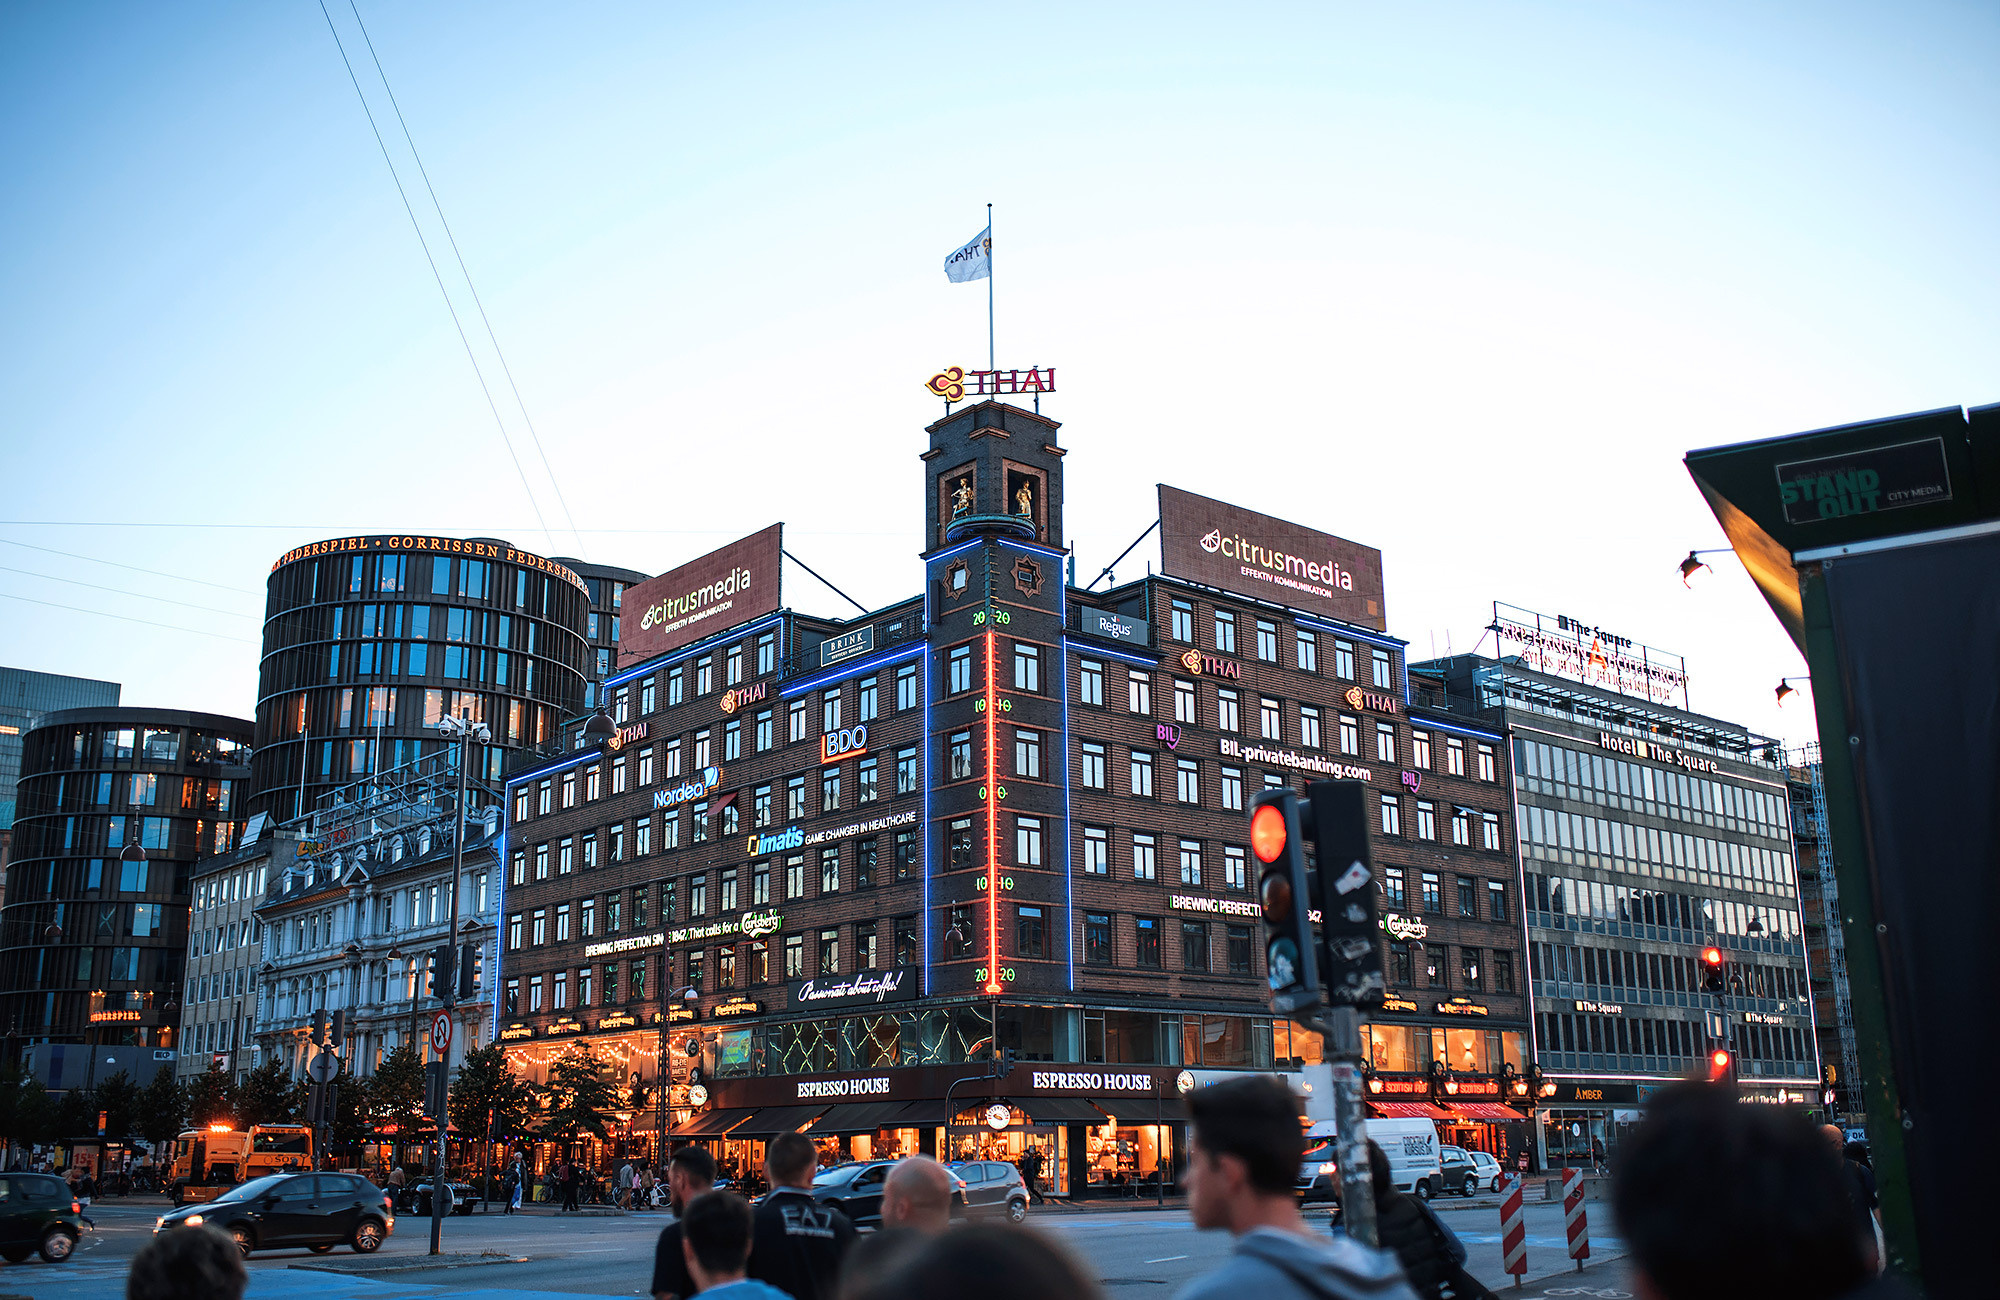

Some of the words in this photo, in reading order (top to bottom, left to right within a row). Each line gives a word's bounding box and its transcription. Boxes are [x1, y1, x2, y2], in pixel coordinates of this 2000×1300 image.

[969, 368, 1057, 395] THAI
[1779, 469, 1880, 505] STAND
[1888, 490, 1910, 502] CITY
[1911, 485, 1944, 498] MEDIA
[1817, 490, 1881, 519] OUT
[283, 538, 368, 565] FEDERSPIEL
[388, 536, 499, 558] GORRISSEN
[1220, 533, 1354, 592] citrusmedia
[1240, 566, 1273, 583] EFFEKTIV
[1273, 575, 1333, 599] KOMMUNIKATION
[653, 567, 751, 625] citrusmedia
[665, 617, 689, 634] EFFEKTIV
[688, 600, 733, 625] KOMMUNIKATION
[973, 611, 986, 625] 20
[995, 610, 1010, 624] 20
[1099, 616, 1131, 638] Regus
[830, 632, 864, 652] BRINK
[1568, 618, 1591, 637] The
[1594, 626, 1632, 649] Square
[1203, 655, 1240, 679] THAI
[736, 682, 767, 707] THAI
[975, 699, 986, 712] 10
[998, 699, 1011, 711] 10
[1364, 692, 1397, 713] THAI
[622, 722, 648, 744] THAI
[827, 725, 867, 756] BDO
[1157, 724, 1176, 743] BIL
[1220, 738, 1372, 782] BIL-privatebanking.com
[1600, 731, 1637, 756] Hotel
[1647, 742, 1673, 764] The
[1675, 749, 1718, 774] Square
[1402, 771, 1418, 788] BIL
[653, 782, 705, 809] Nordea
[979, 786, 987, 800] 0
[997, 786, 1006, 799] 0
[758, 825, 805, 856] imatis
[805, 833, 826, 846] GAME
[825, 824, 860, 841] CHANGER
[860, 822, 869, 834] IN
[869, 811, 917, 831] HEALTHCARE
[976, 877, 988, 891] 10
[1000, 876, 1013, 890] 10
[1172, 894, 1219, 913] BREWING
[1386, 913, 1430, 940] Carlsberg
[585, 941, 613, 957] BREWING
[613, 934, 652, 953] PERFECTION
[689, 925, 705, 940] That
[705, 923, 722, 938] calls
[722, 921, 734, 935] for
[741, 908, 781, 938] Carlsberg
[847, 974, 880, 996] about
[975, 968, 988, 982] 20
[1000, 967, 1015, 982] 20
[1583, 1001, 1597, 1012] The
[1598, 1002, 1623, 1015] Square
[1751, 1013, 1763, 1023] The
[1763, 1014, 1783, 1025] Square
[797, 1079, 849, 1098] ESPRESSO
[850, 1077, 890, 1096] HOUSE
[1032, 1071, 1102, 1090] ESPRESSO
[1103, 1073, 1152, 1091] HOUSE
[1385, 1081, 1414, 1093] SCOTTISH
[1414, 1082, 1428, 1094] PUB
[1459, 1082, 1486, 1094] SCOTTISH
[1486, 1083, 1499, 1095] PUB
[781, 1205, 832, 1230] EA7
